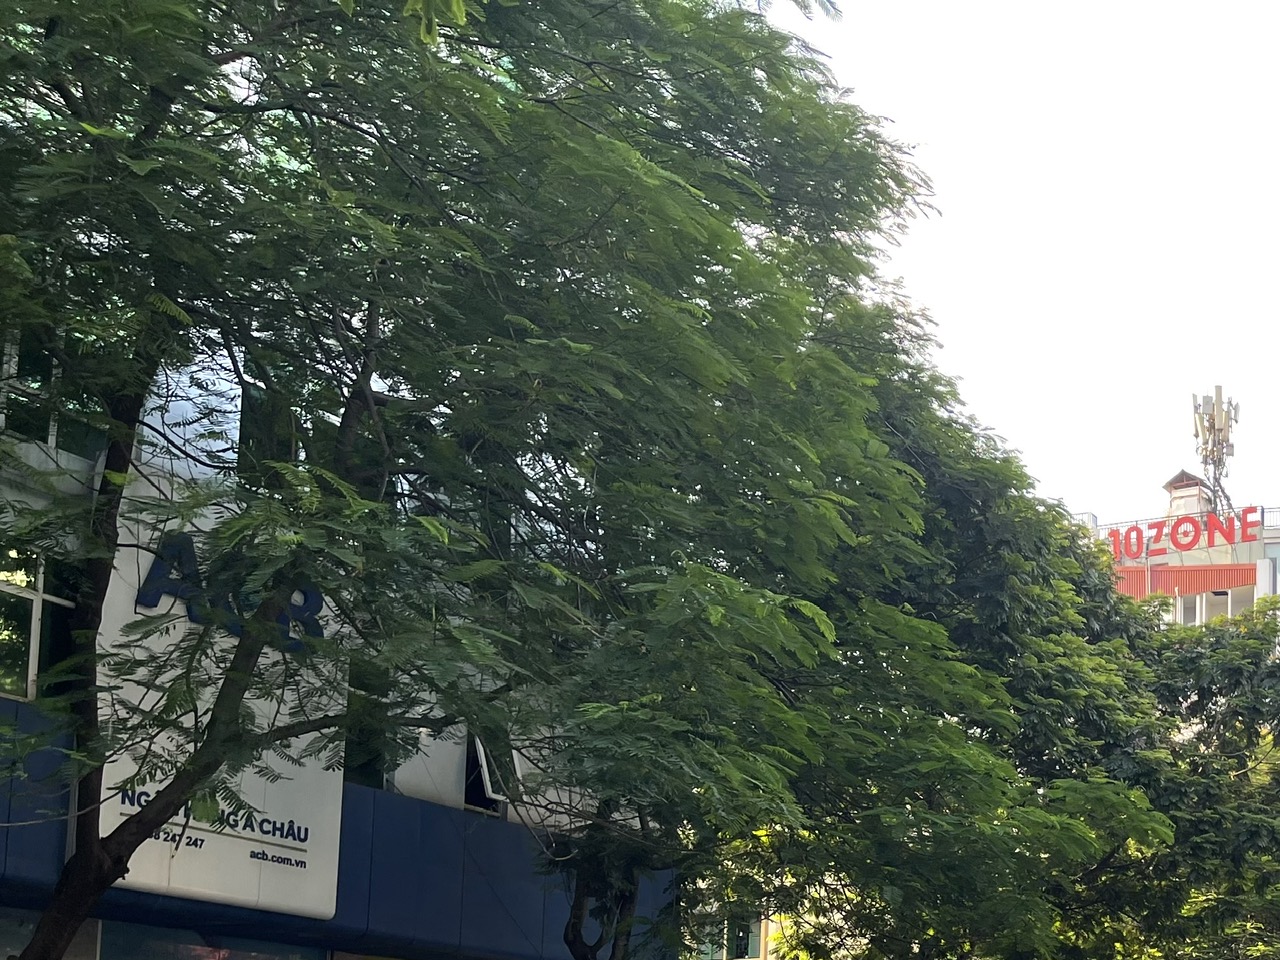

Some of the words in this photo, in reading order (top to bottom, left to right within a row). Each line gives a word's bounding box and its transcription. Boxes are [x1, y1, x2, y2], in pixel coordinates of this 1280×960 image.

[259, 818, 309, 843] CHÂU
[185, 836, 206, 850] 247
[249, 849, 307, 869] acb.com.vn
